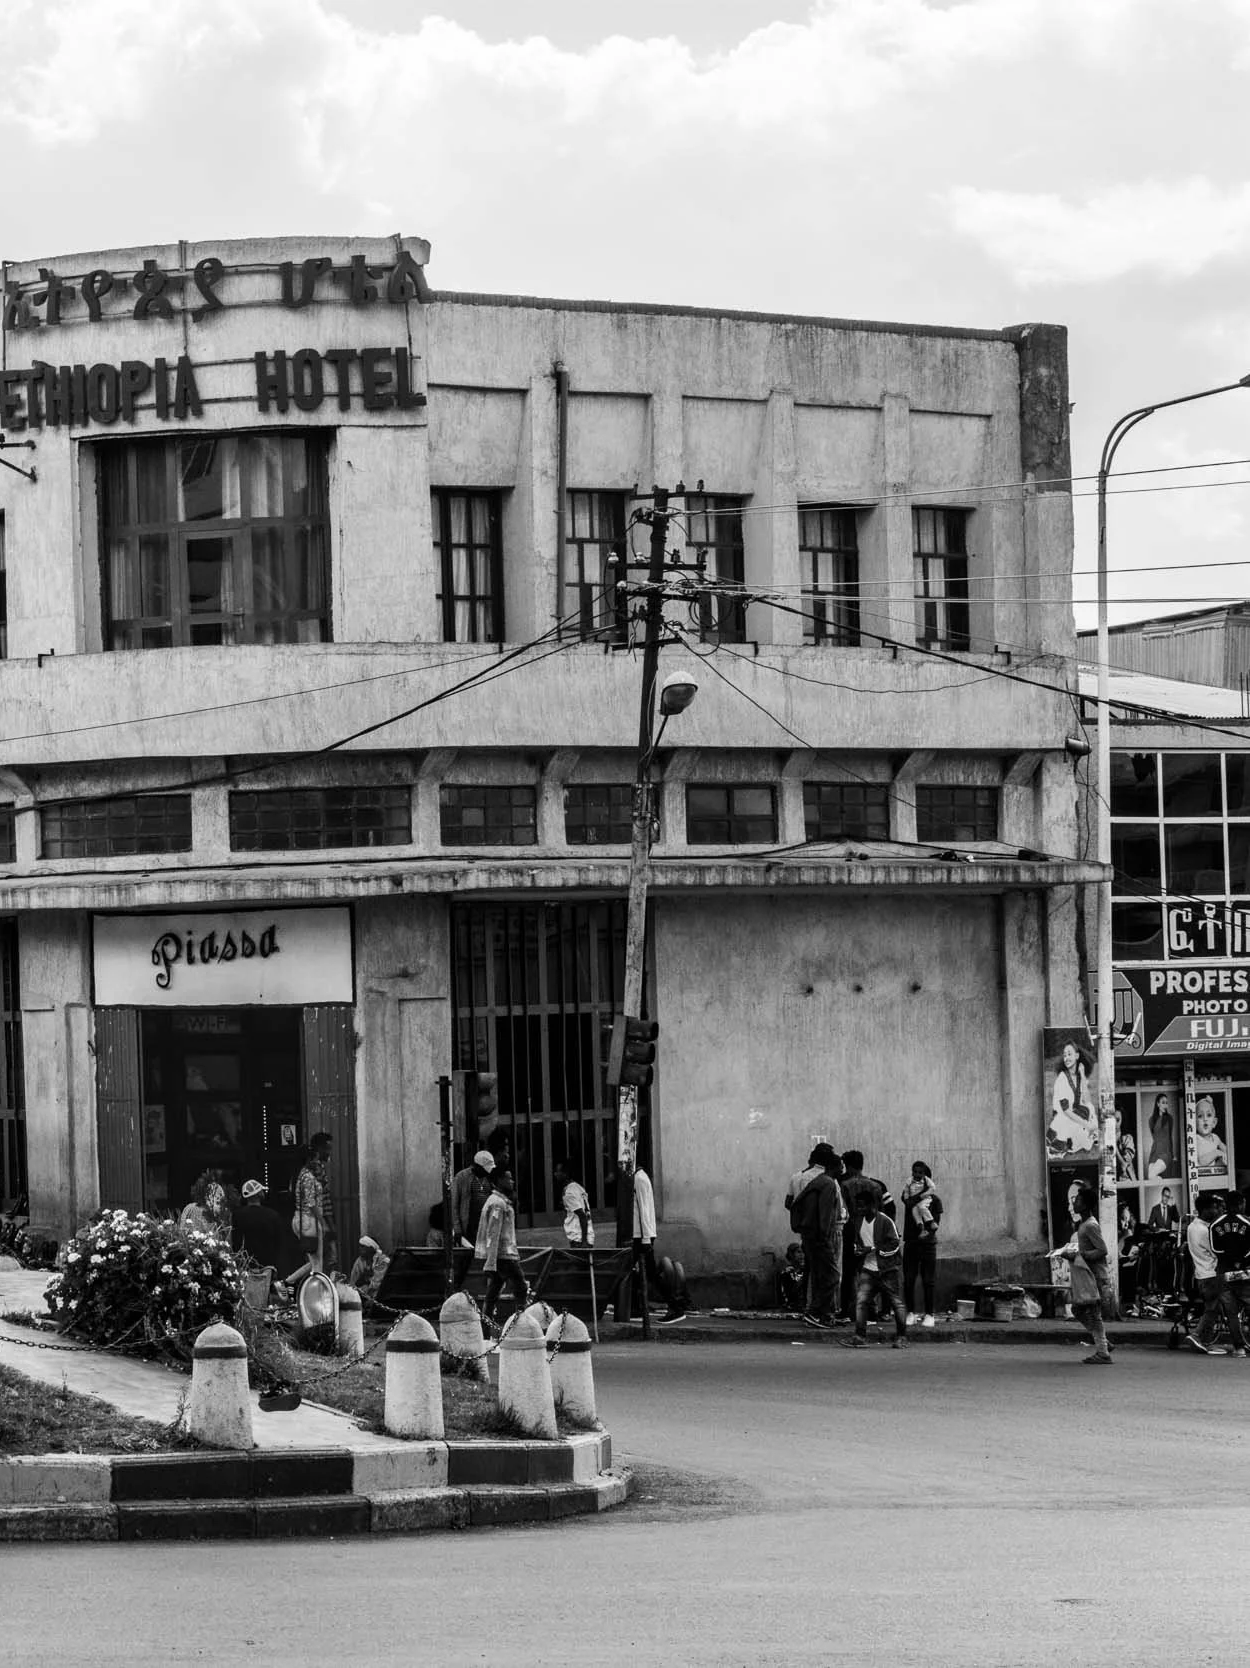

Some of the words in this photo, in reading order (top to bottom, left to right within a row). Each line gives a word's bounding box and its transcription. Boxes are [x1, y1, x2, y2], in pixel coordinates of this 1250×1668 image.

[3, 257, 226, 331] ኢትዮጵያ
[281, 251, 431, 309] ሆቴል
[254, 346, 427, 413] HOTEL
[151, 923, 281, 989] Piassa
[1150, 970, 1249, 995] PROFES
[1182, 999, 1248, 1015] PHOTO
[1186, 1040, 1224, 1051] Digital
